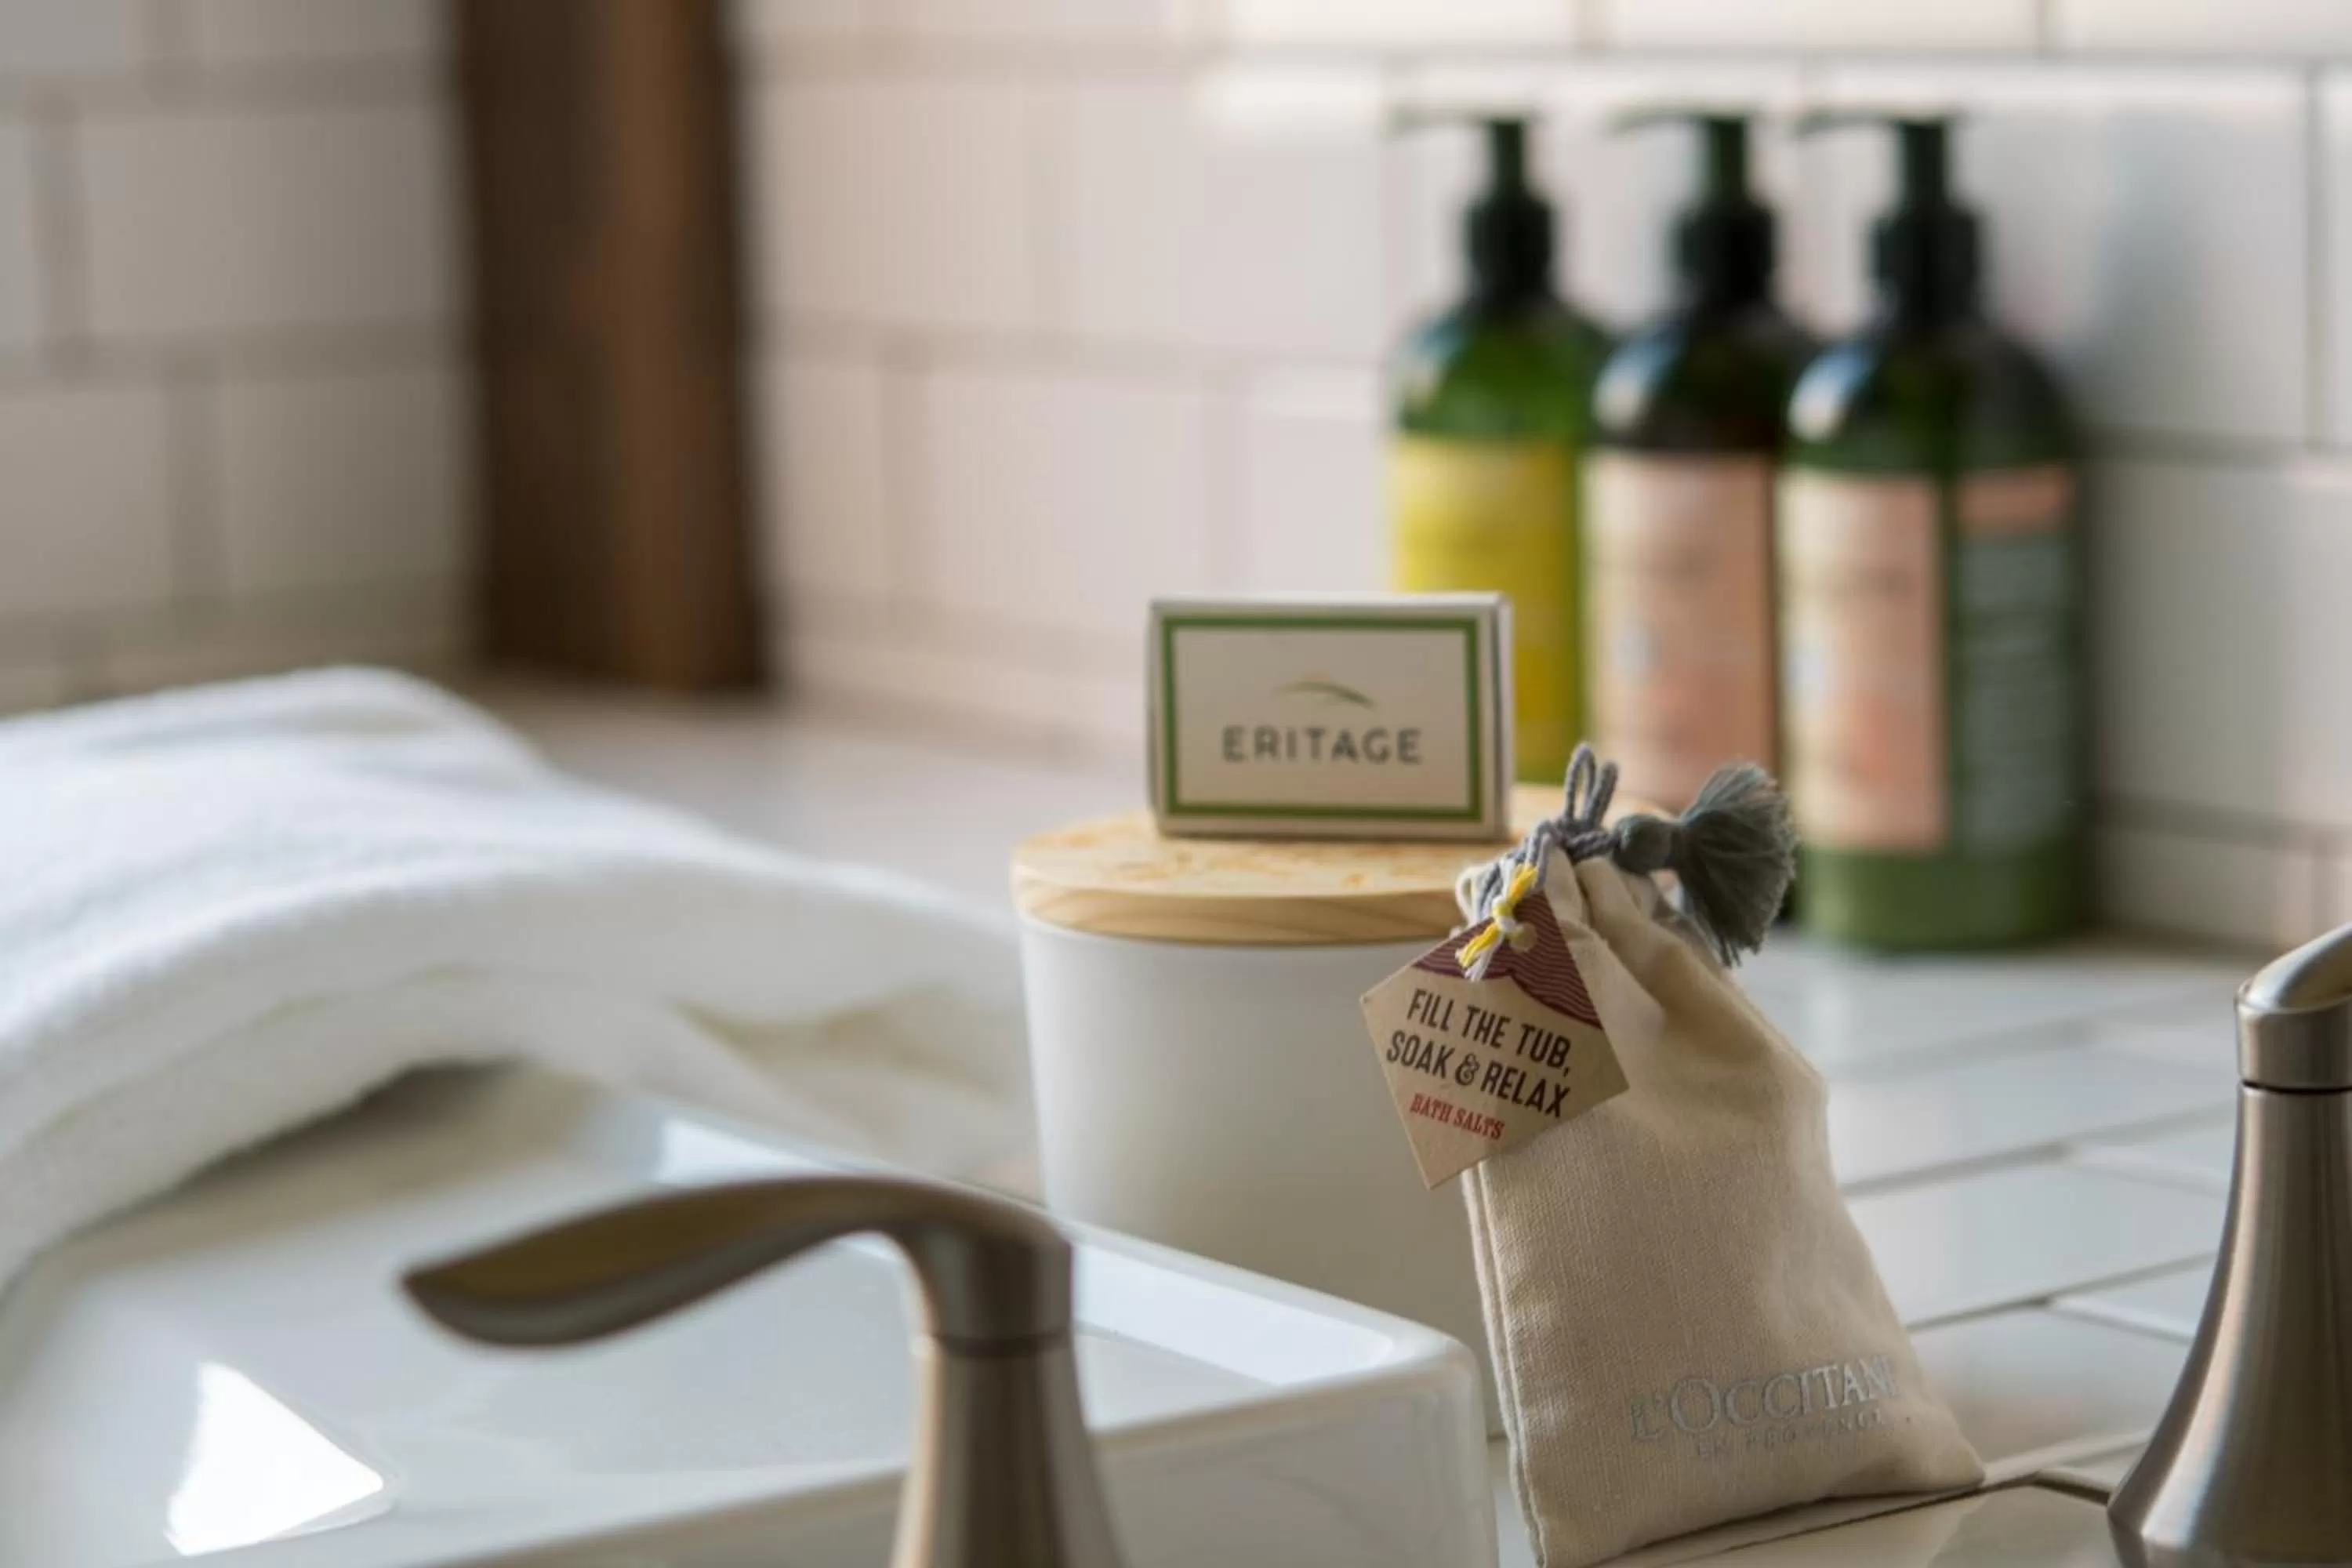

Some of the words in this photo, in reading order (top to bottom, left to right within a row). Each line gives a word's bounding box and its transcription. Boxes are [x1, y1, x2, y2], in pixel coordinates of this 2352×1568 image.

[1221, 724, 1423, 765] ERITAGE
[1406, 989, 1454, 1032] FILL
[1461, 1004, 1511, 1050] THE
[1515, 1022, 1573, 1077] TUB,
[1386, 1029, 1456, 1080] SOAK
[1455, 1052, 1481, 1087] &
[1479, 1062, 1571, 1119] RELAX
[1409, 1093, 1454, 1124] BATH
[1453, 1107, 1505, 1141] SALTS
